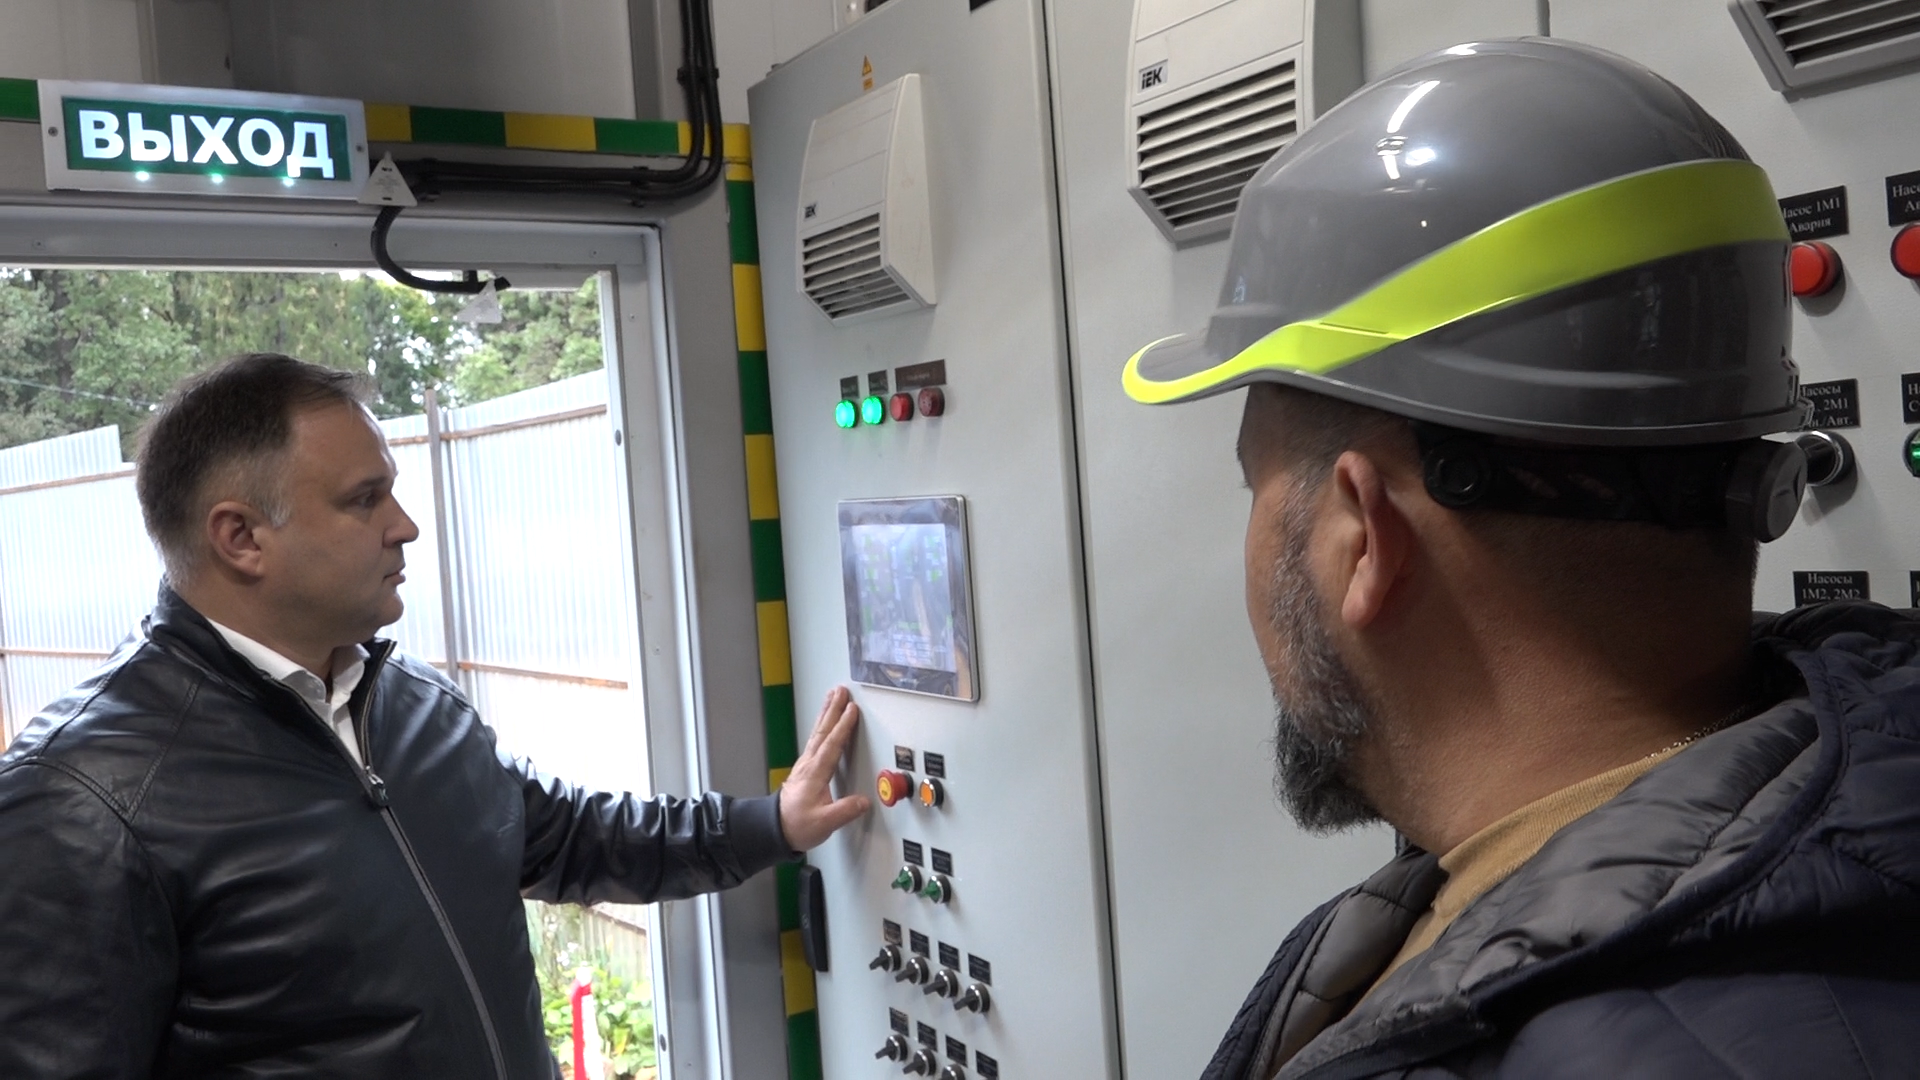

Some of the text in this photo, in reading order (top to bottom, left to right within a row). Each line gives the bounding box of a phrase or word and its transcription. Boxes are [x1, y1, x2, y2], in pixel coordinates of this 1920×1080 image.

[78, 109, 335, 179] ВЫХОД
[1790, 217, 1831, 233] Авария
[1807, 572, 1853, 585] Насосы
